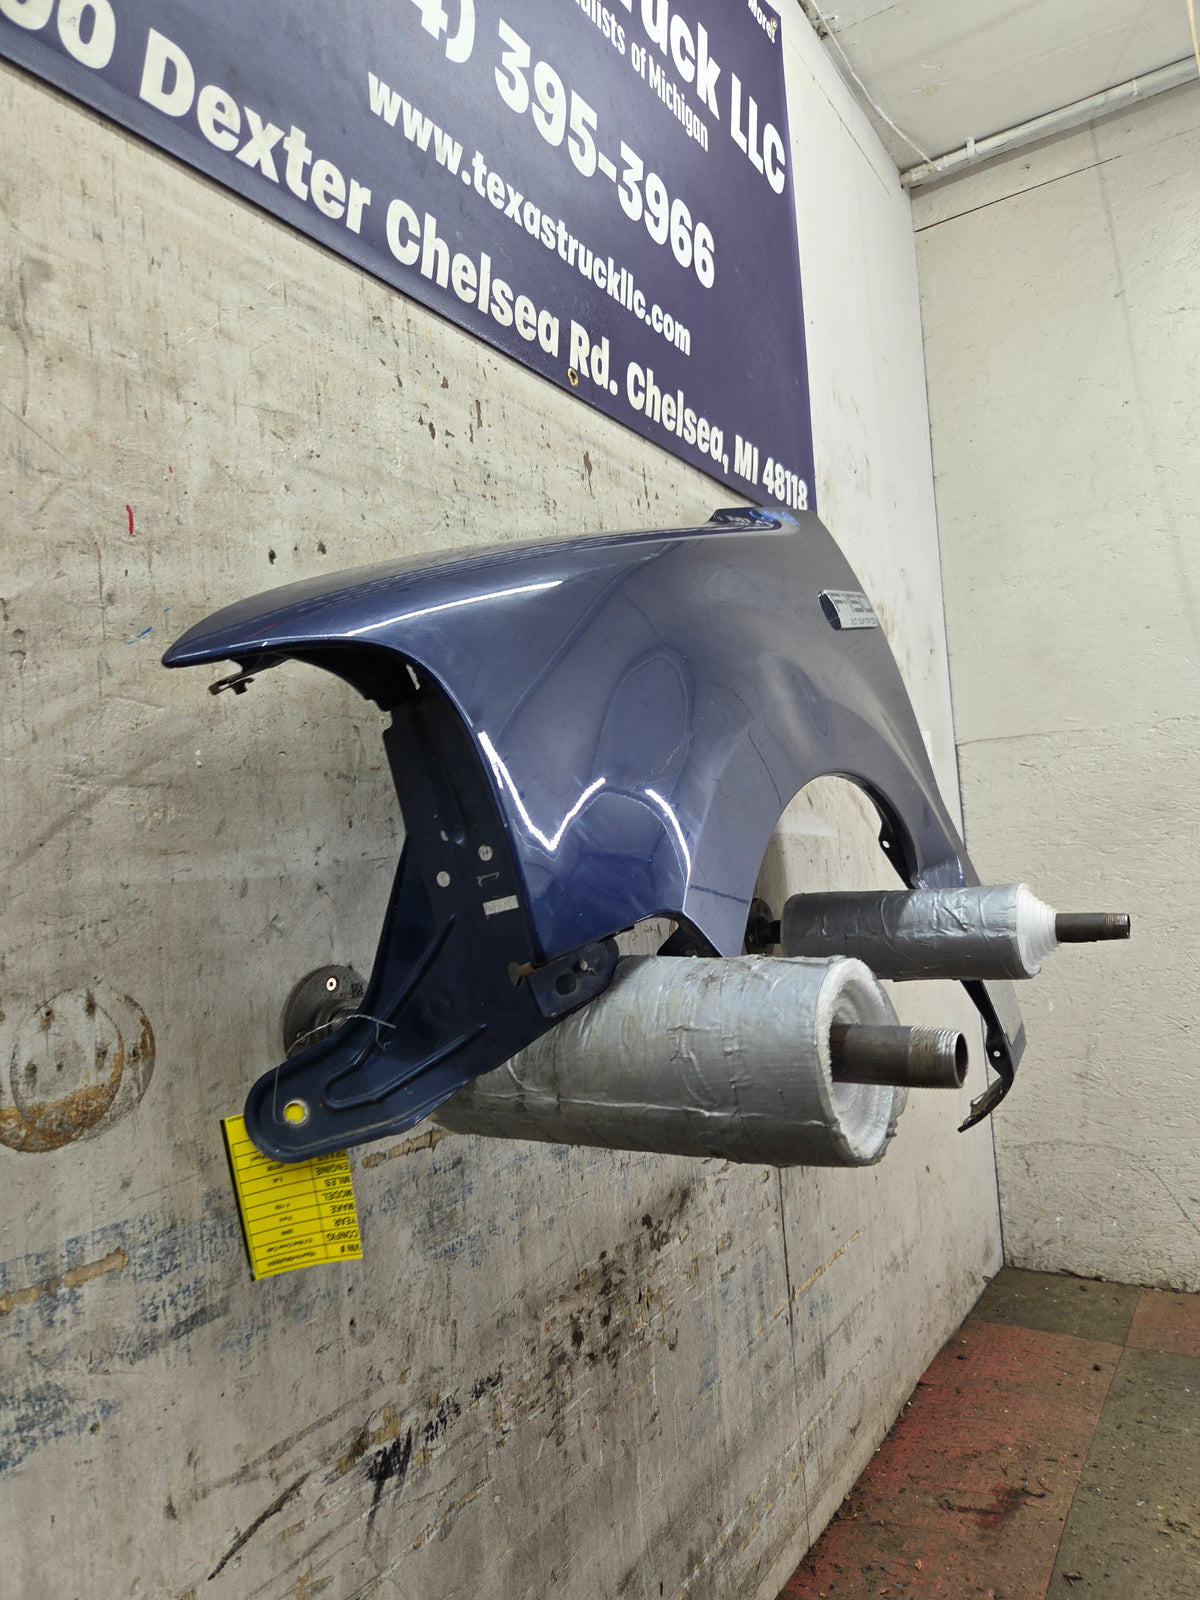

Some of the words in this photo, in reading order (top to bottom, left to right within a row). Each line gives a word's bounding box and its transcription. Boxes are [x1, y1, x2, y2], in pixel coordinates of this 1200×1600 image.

[620, 0, 721, 120] uck
[731, 72, 785, 194] LLC
[631, 42, 646, 79] of
[649, 54, 709, 152] Michigan
[495, 18, 715, 288] 395-3966
[367, 72, 692, 355] www.texastruckllc.com
[139, 28, 371, 234] Dexter
[386, 199, 560, 357] Chelsea
[569, 319, 619, 396] Rd.
[626, 361, 729, 475] Chelsea,
[734, 434, 759, 485] MI
[762, 457, 808, 511] 48118
[322, 1189, 353, 1201] MODEL
[326, 1229, 359, 1242] CONFIG
[330, 1203, 355, 1213] MAKE
[333, 1216, 356, 1227] YEAR
